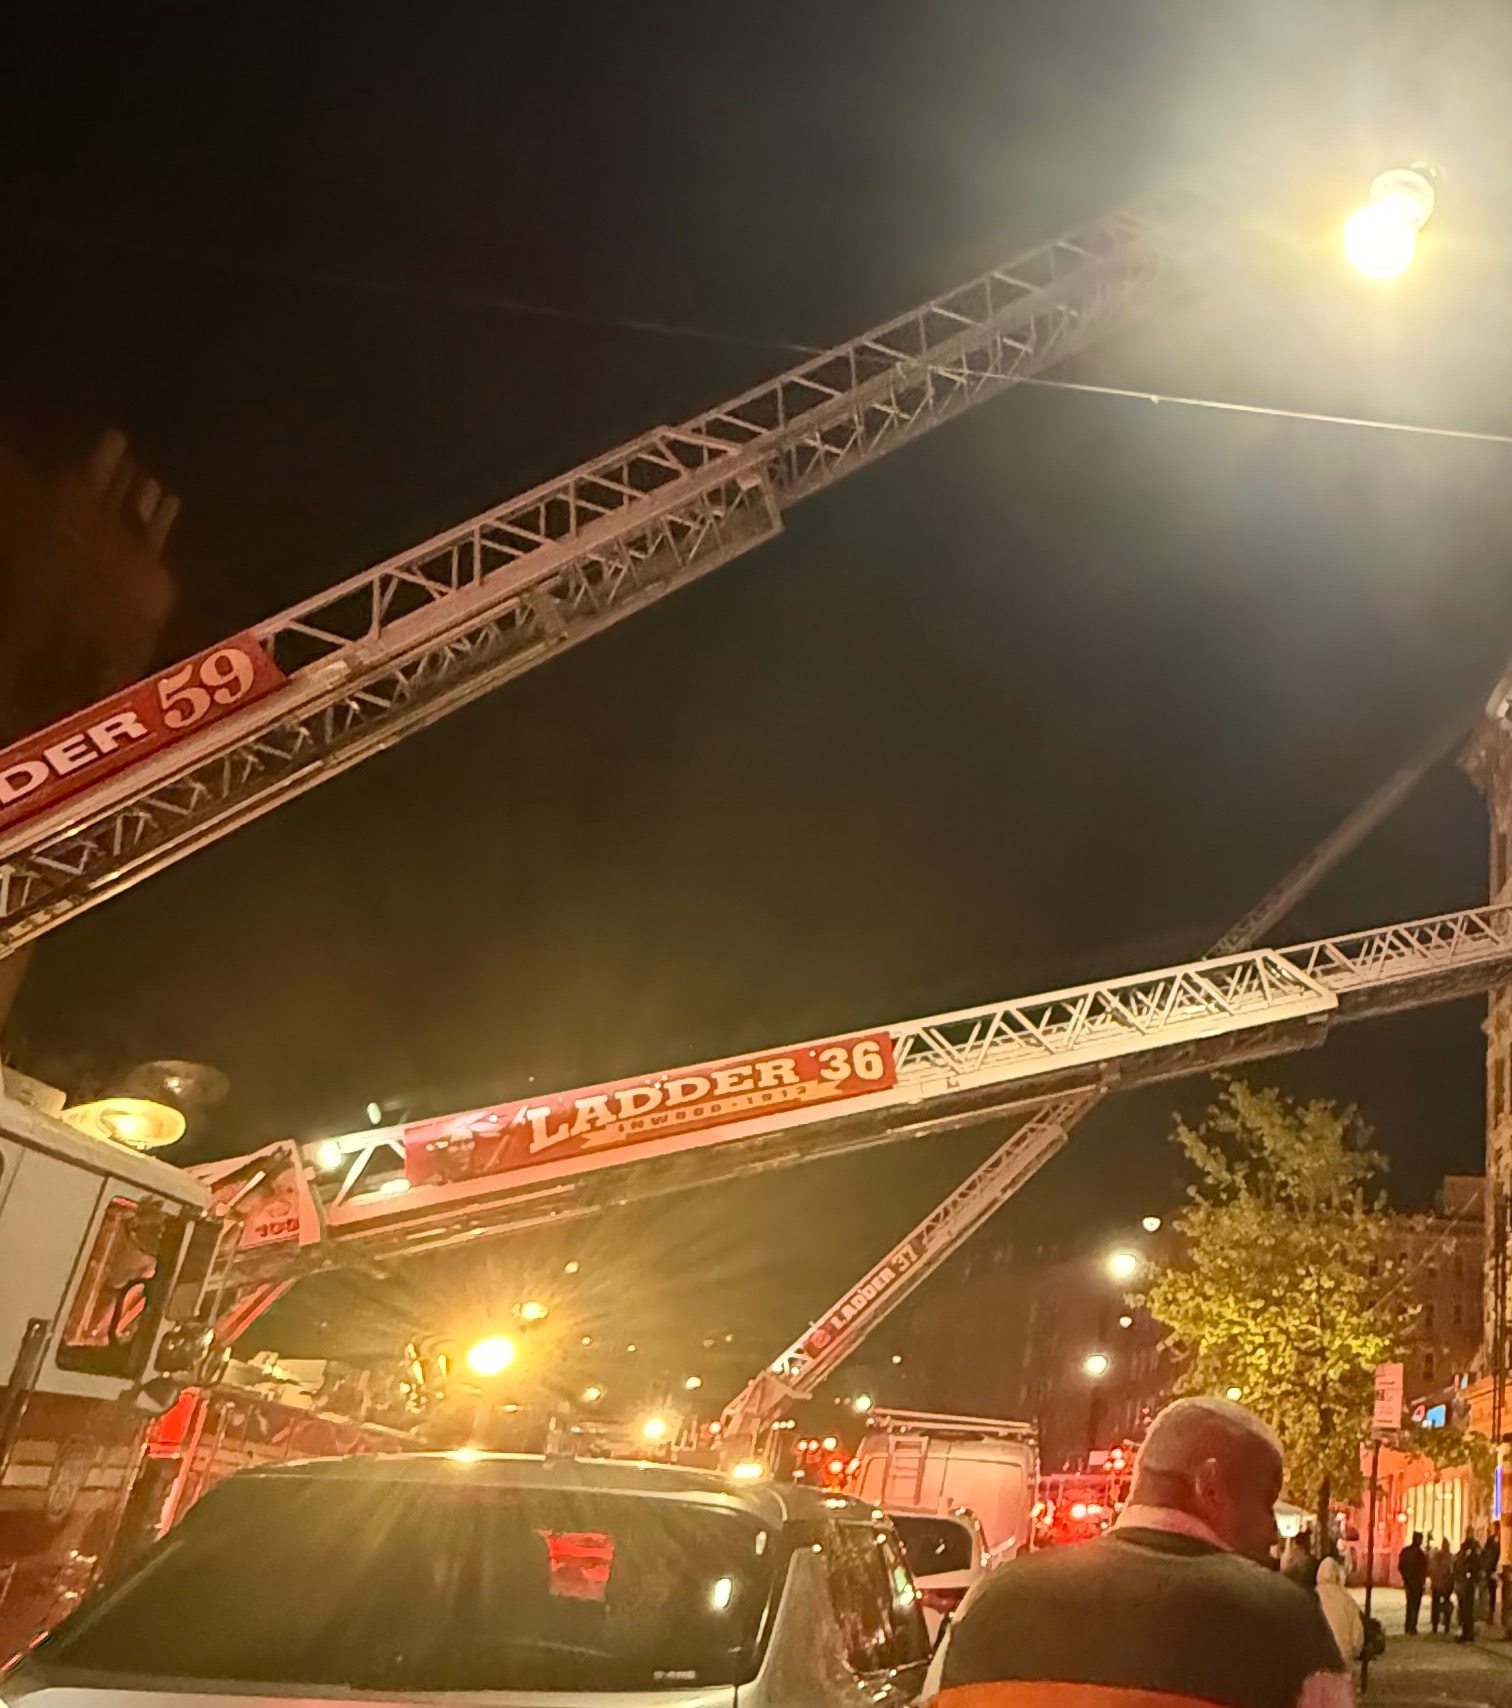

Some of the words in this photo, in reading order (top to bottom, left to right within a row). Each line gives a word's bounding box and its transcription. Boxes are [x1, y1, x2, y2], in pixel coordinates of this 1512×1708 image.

[0, 710, 148, 801] DER
[157, 648, 254, 729] 59
[527, 1057, 799, 1153] LADDER
[819, 1041, 884, 1080] 36
[831, 1267, 896, 1329] LADDER
[892, 1244, 918, 1271] 37
